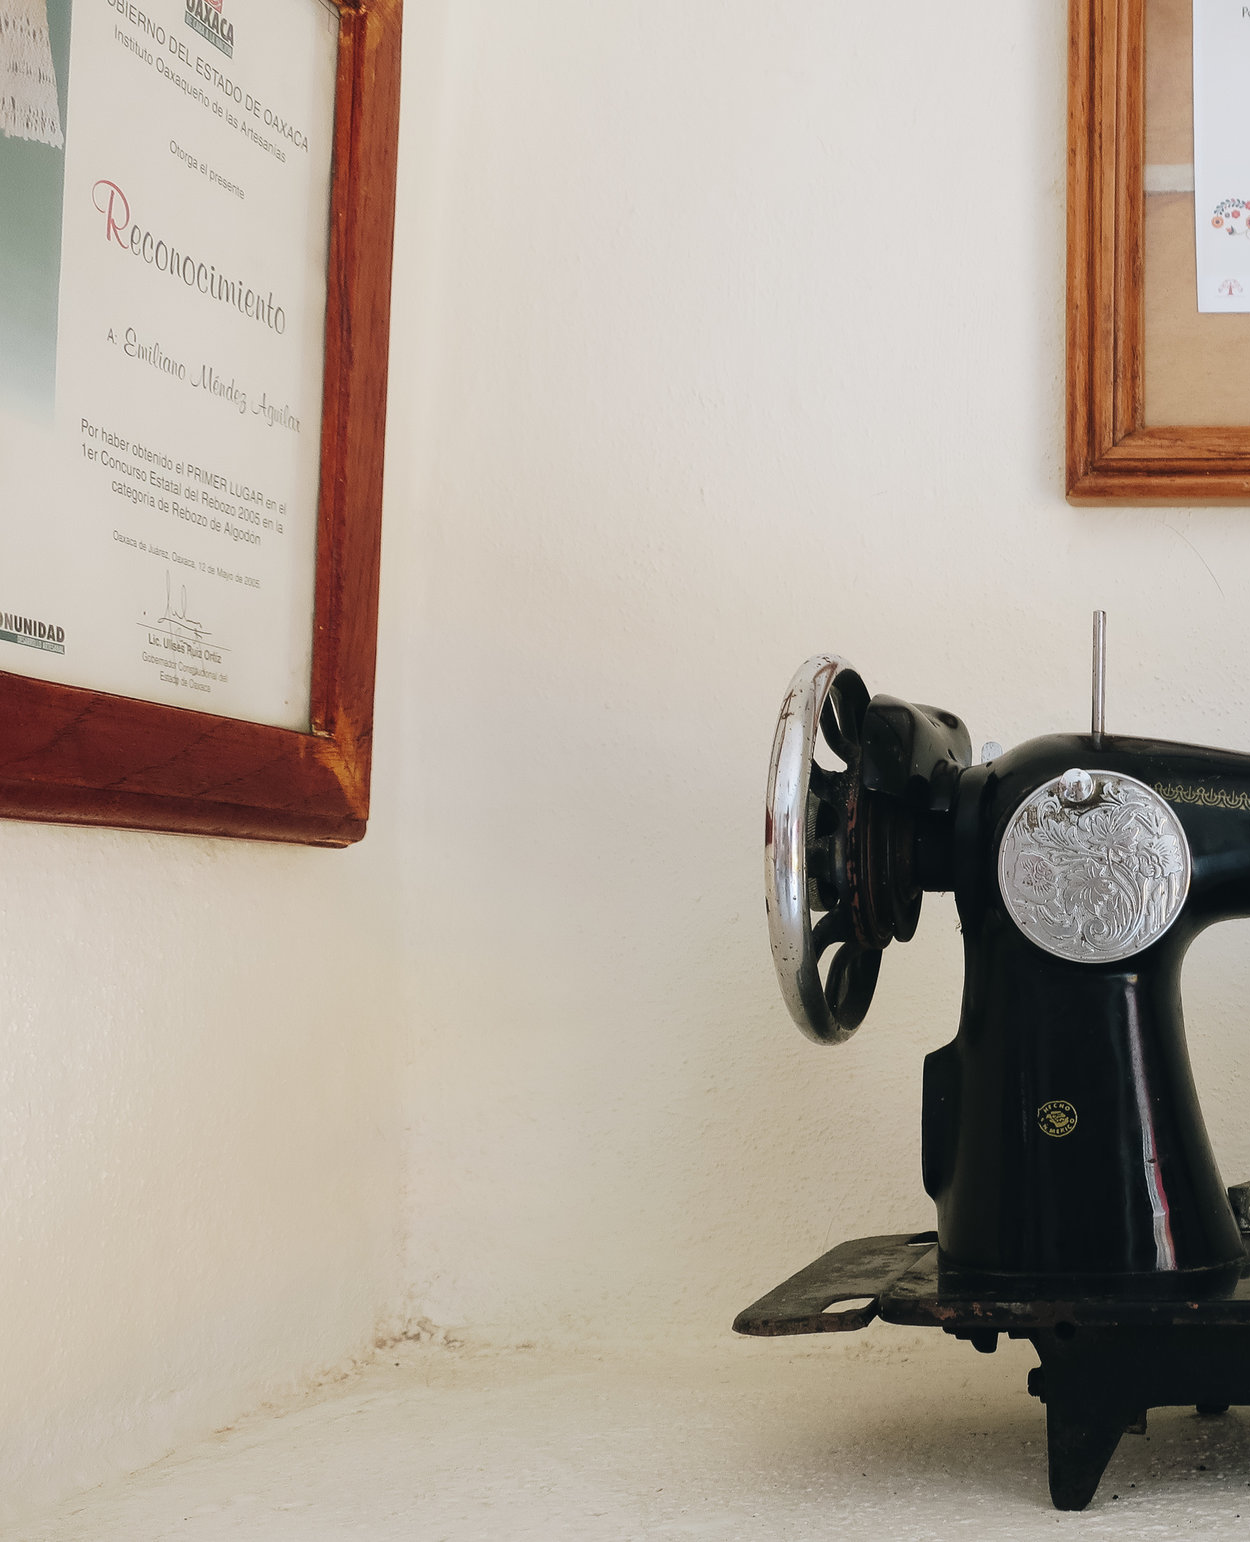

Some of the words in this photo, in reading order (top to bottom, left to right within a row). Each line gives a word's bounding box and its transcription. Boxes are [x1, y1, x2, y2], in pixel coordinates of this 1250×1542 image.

[114, 24, 154, 66] Instituto
[155, 57, 210, 108] Oaxaqueño
[212, 100, 224, 118] de
[225, 109, 239, 129] las
[168, 35, 193, 68] DEL
[195, 57, 243, 103] ESTADO
[245, 94, 261, 119] DE
[263, 109, 309, 153] OAXACA
[169, 140, 198, 170] Otorga
[200, 162, 208, 177] el
[209, 169, 245, 200] presente
[91, 179, 286, 335] Reconocimiento
[106, 327, 118, 345] A:
[123, 327, 187, 381] Emiliano
[189, 364, 248, 415] Méndez
[81, 417, 99, 438] Por
[101, 427, 130, 451] haber
[132, 443, 173, 471] obtenido
[175, 461, 185, 476] el
[187, 463, 228, 492] PRIMER
[229, 481, 265, 507] LUGAR
[265, 498, 278, 512] en
[278, 502, 288, 516] el
[81, 443, 99, 462] 1er
[100, 450, 148, 482] Concurso
[149, 470, 182, 497] Estatal
[184, 486, 199, 502] del
[201, 491, 237, 517] Rebozo
[238, 505, 261, 527] 2005
[262, 516, 274, 531] en
[275, 520, 285, 535] la
[112, 529, 138, 549] Oaxaca
[139, 541, 147, 552] de
[207, 564, 216, 575] de
[216, 567, 234, 582] Mayo
[157, 498, 170, 514] de
[172, 501, 208, 528] Rebozo
[210, 517, 222, 532] de
[148, 633, 162, 647] Lic.
[203, 649, 223, 665] Ortiz
[1042, 1103, 1071, 1113] HECHO
